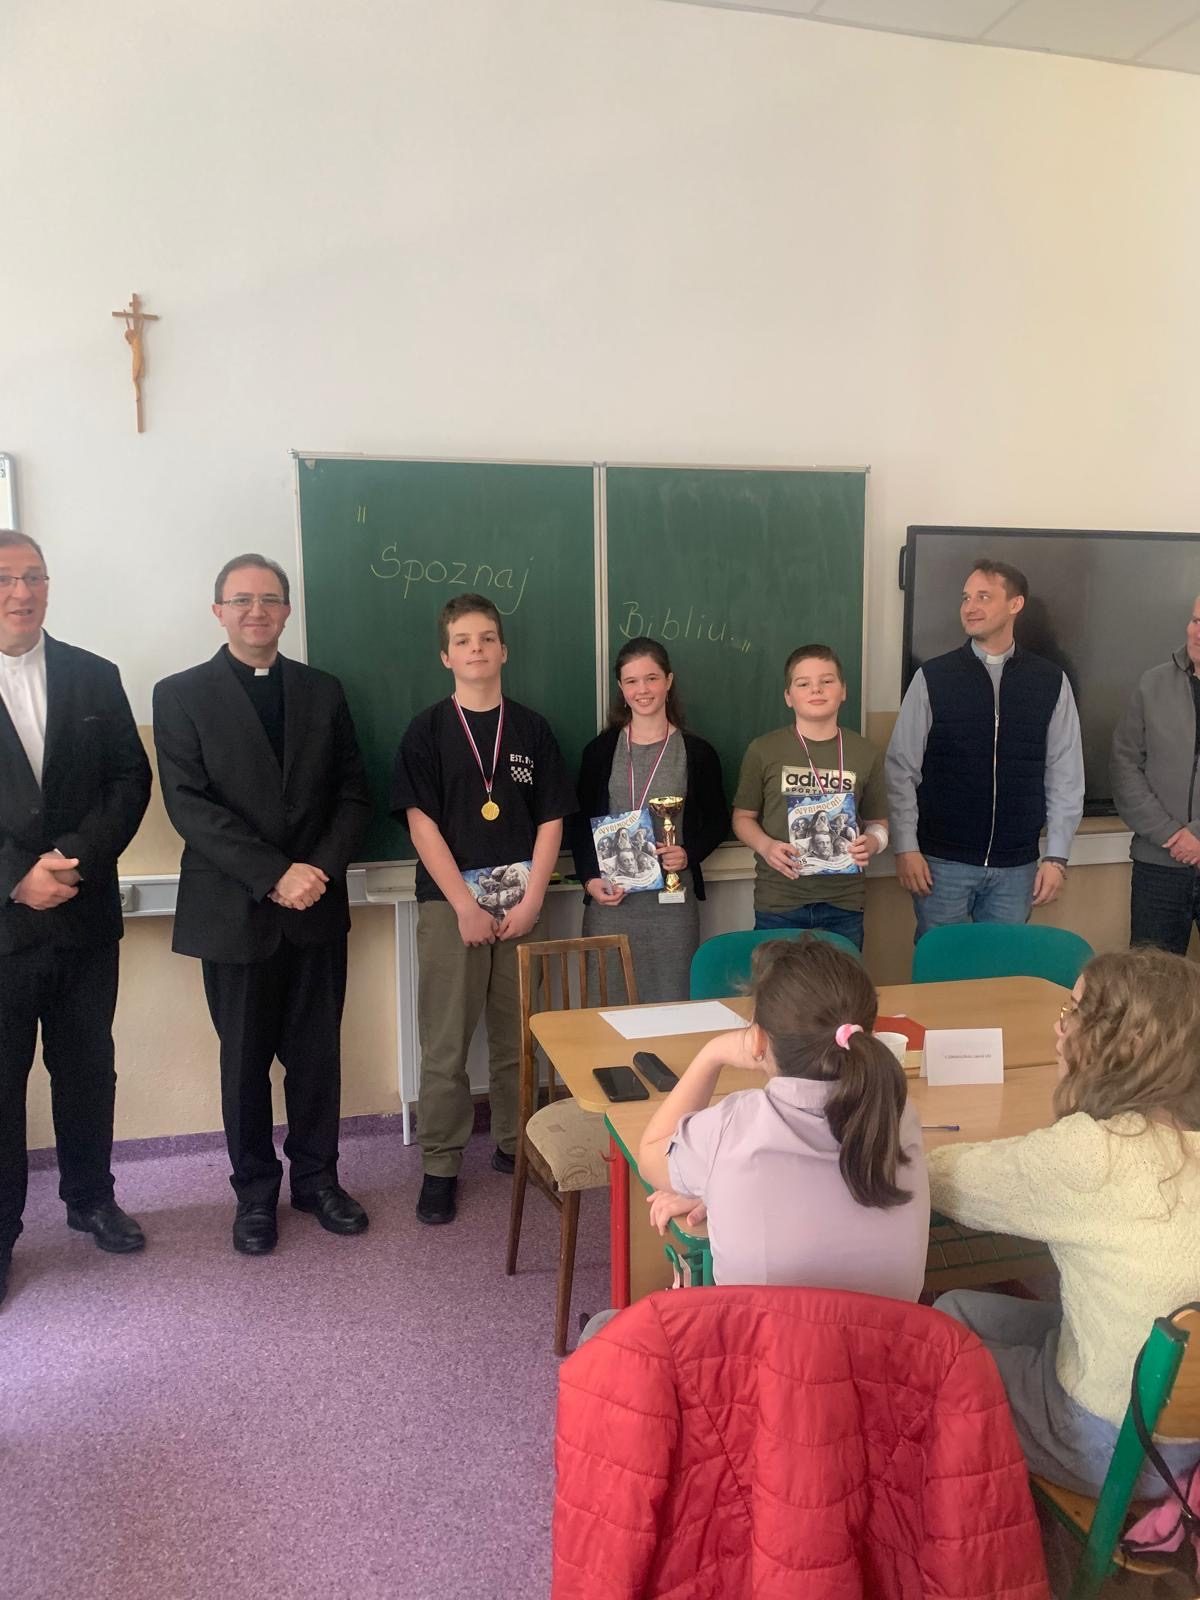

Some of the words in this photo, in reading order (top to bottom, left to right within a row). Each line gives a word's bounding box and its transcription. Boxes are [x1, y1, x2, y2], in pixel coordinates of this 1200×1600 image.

[371, 542, 534, 615] Spoznaj
[509, 753, 525, 764] EST.
[785, 771, 853, 791] adidas
